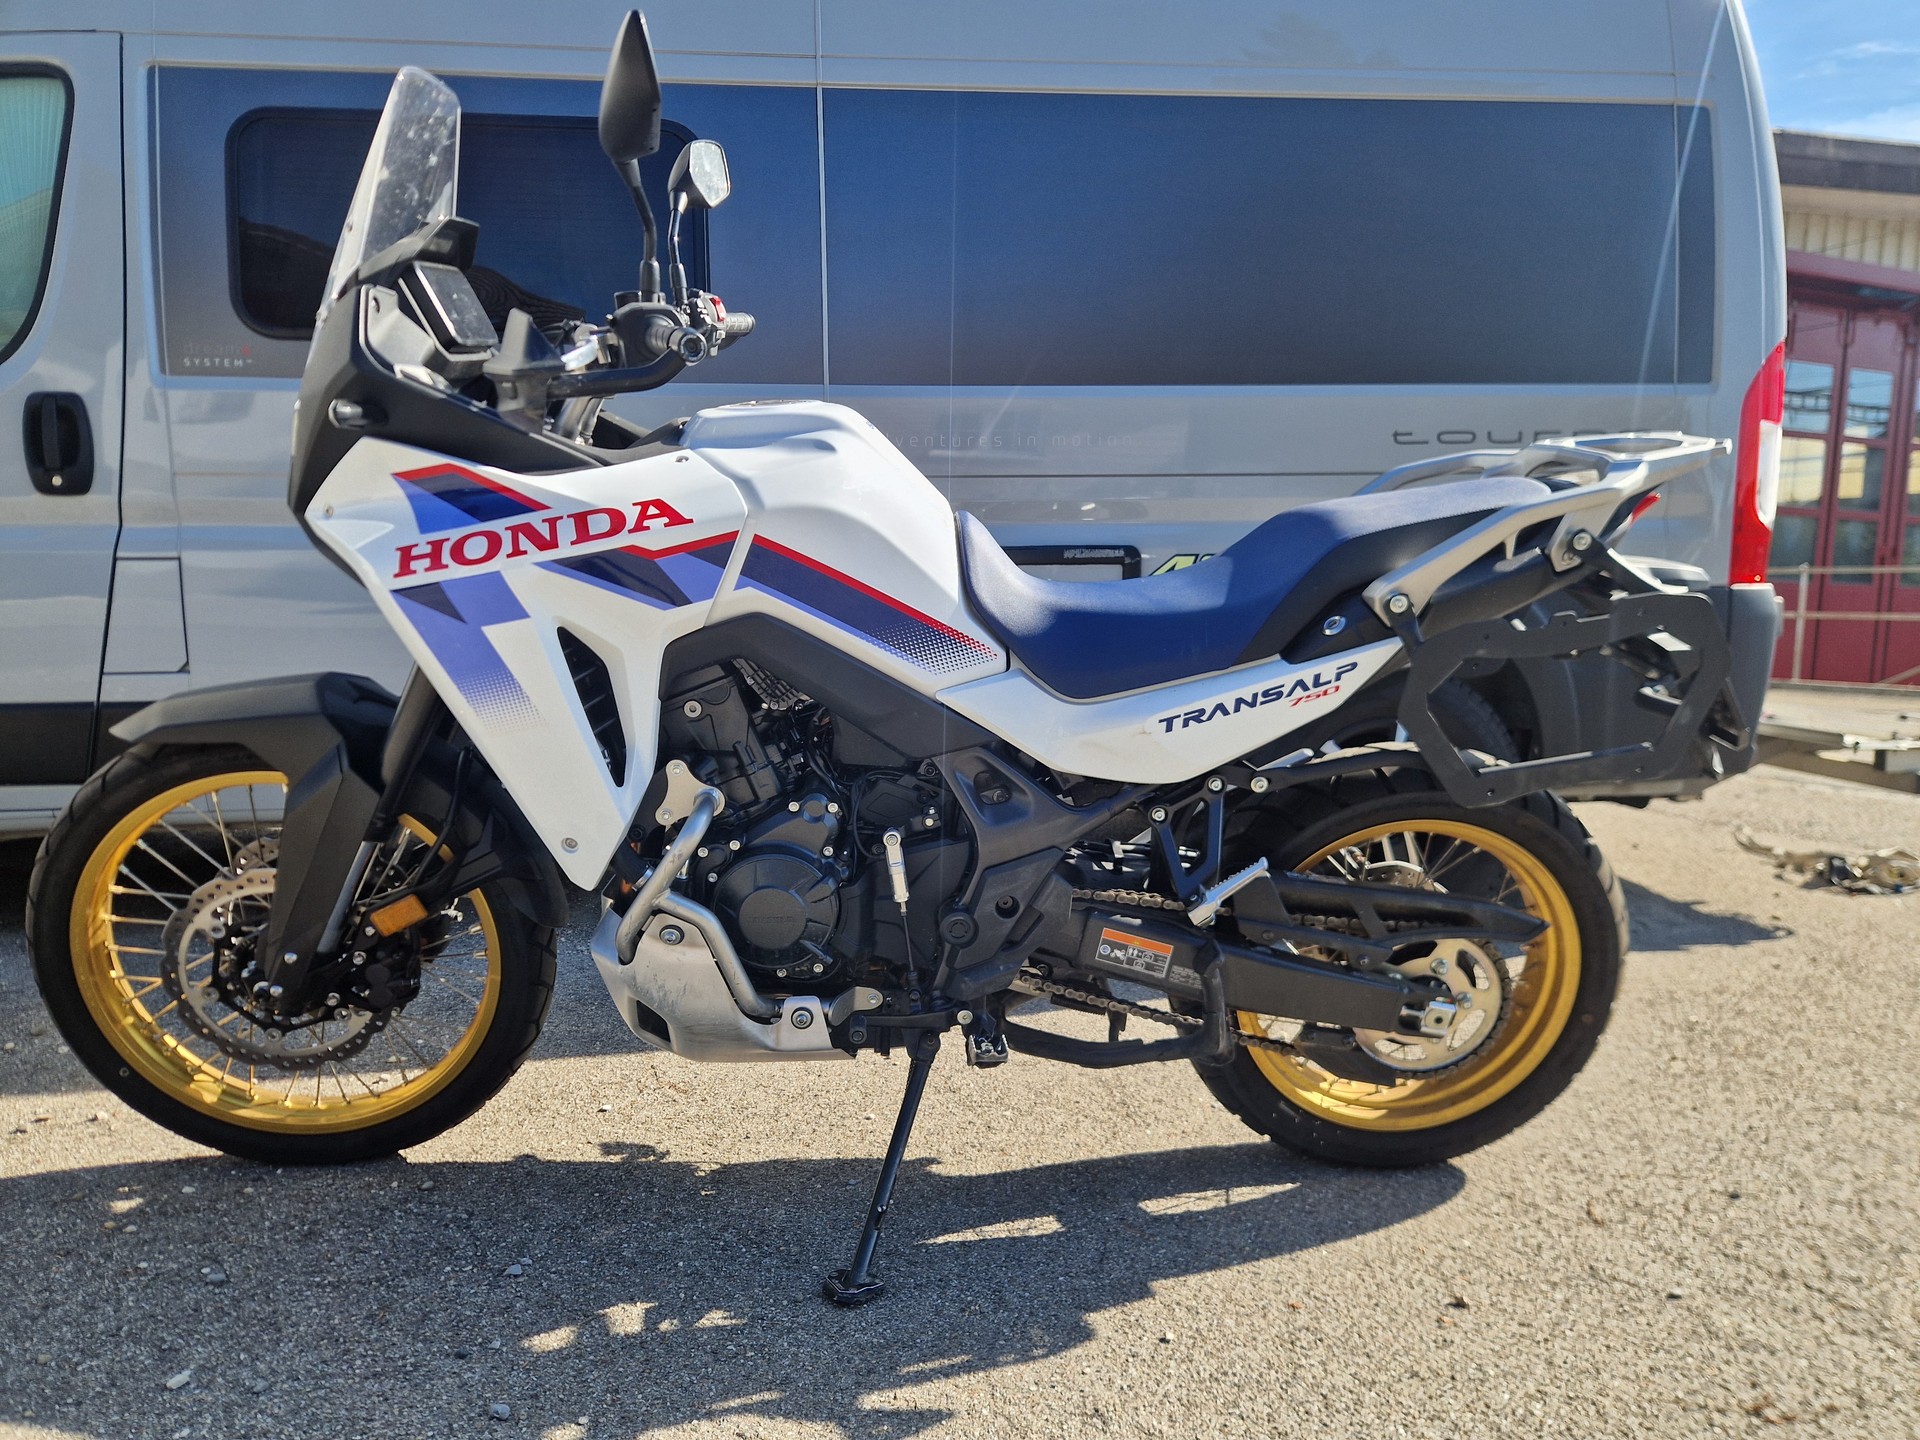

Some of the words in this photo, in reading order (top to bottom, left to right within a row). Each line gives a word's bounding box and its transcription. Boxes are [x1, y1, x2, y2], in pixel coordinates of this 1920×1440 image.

[886, 432, 1003, 447] ventures
[1017, 432, 1036, 447] in
[1051, 432, 1132, 447] motion
[393, 498, 694, 578] HONDA
[1158, 661, 1358, 734] TRANSALP
[1288, 685, 1342, 707] 750
